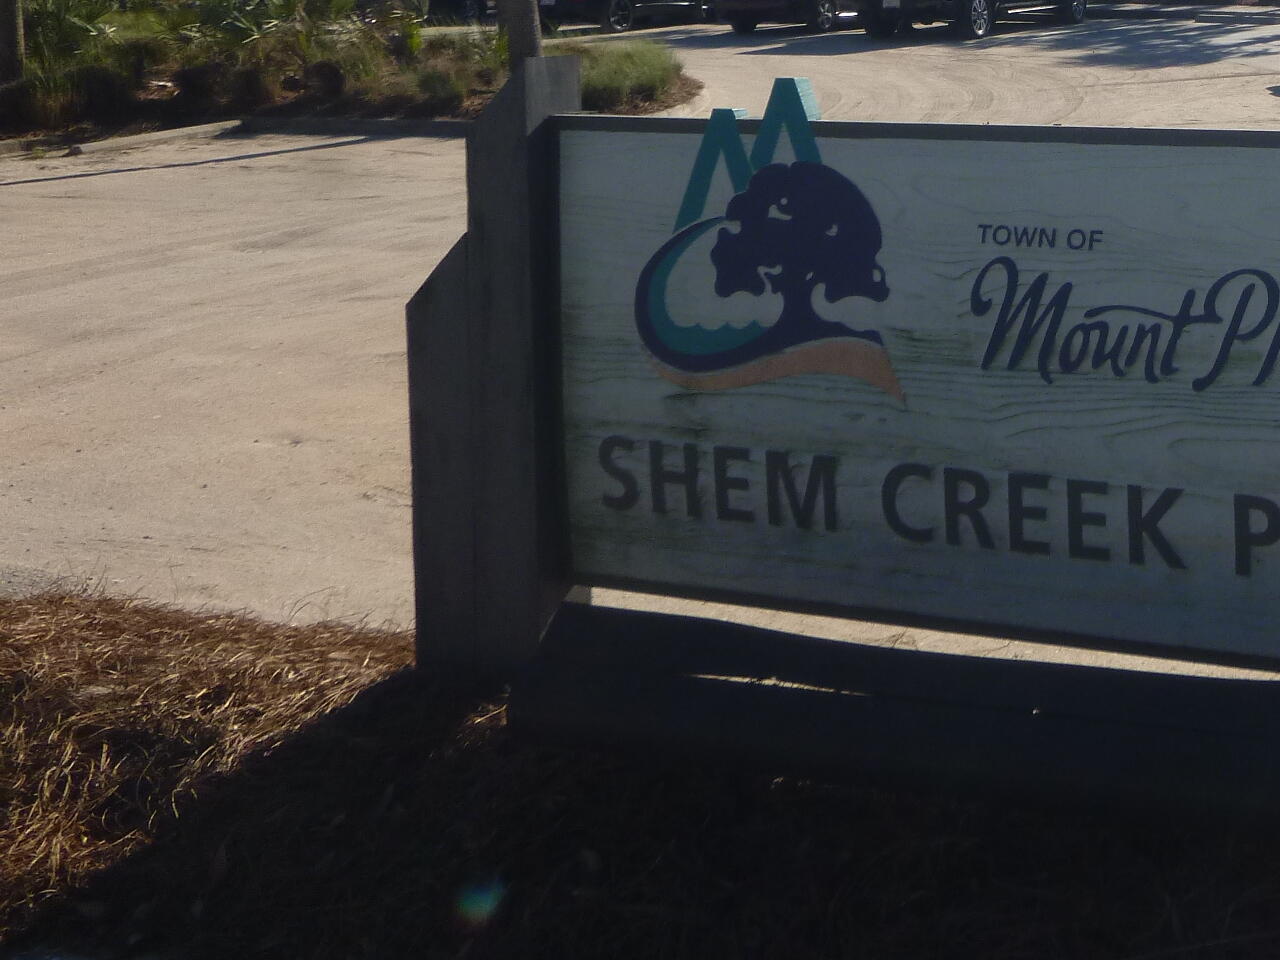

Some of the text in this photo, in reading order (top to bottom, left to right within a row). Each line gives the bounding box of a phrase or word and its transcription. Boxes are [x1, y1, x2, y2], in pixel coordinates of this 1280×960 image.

[977, 223, 1104, 252] TOWN OF
[969, 255, 1219, 385] Mount
[600, 434, 840, 532] SHEM
[881, 462, 1188, 570] CREEK
